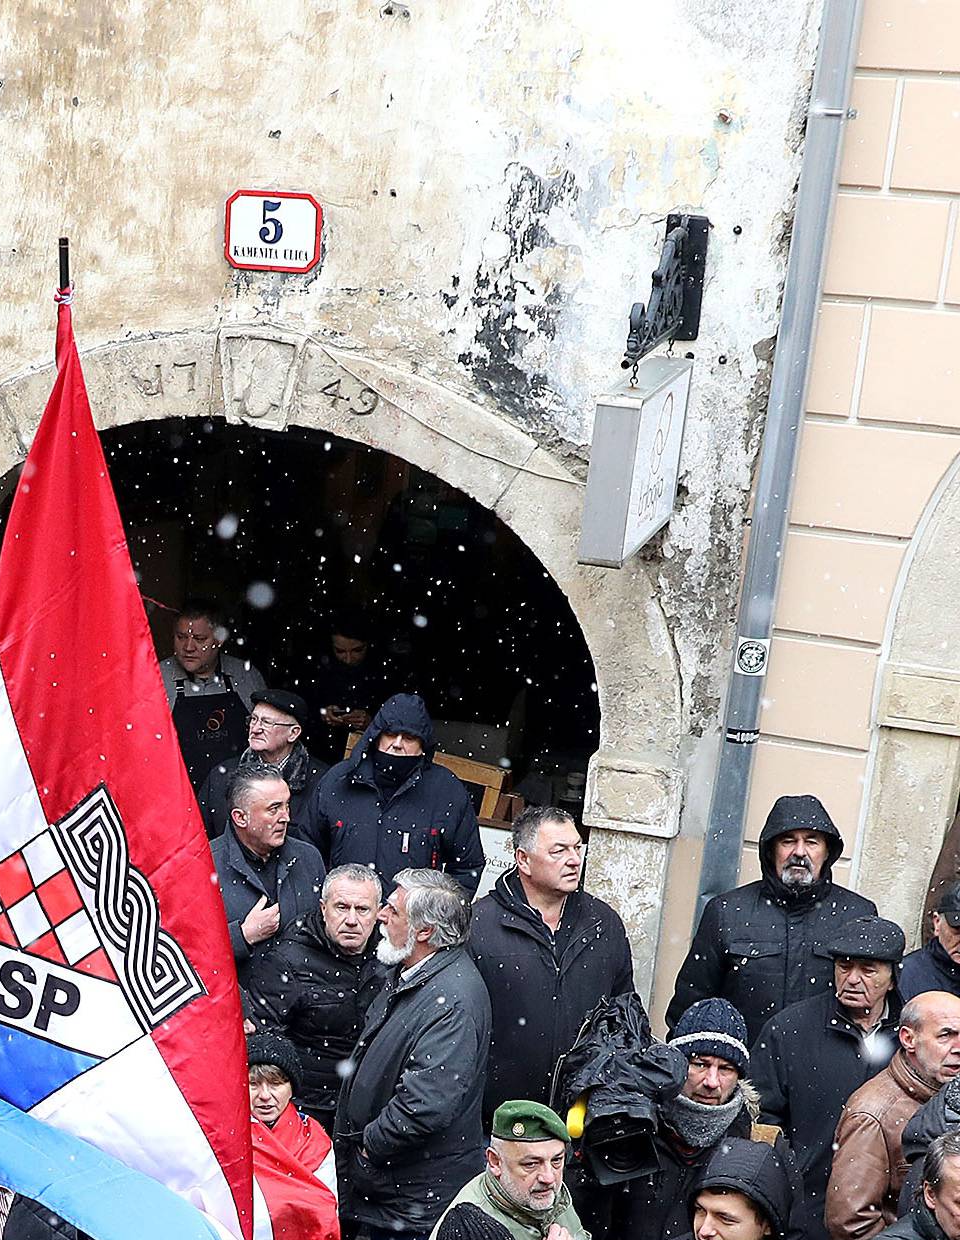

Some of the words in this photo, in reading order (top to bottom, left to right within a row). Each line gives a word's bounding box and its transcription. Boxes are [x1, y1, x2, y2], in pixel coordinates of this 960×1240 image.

[259, 200, 283, 244] 5
[233, 246, 278, 260] KAMENITA
[283, 248, 308, 261] ULICA
